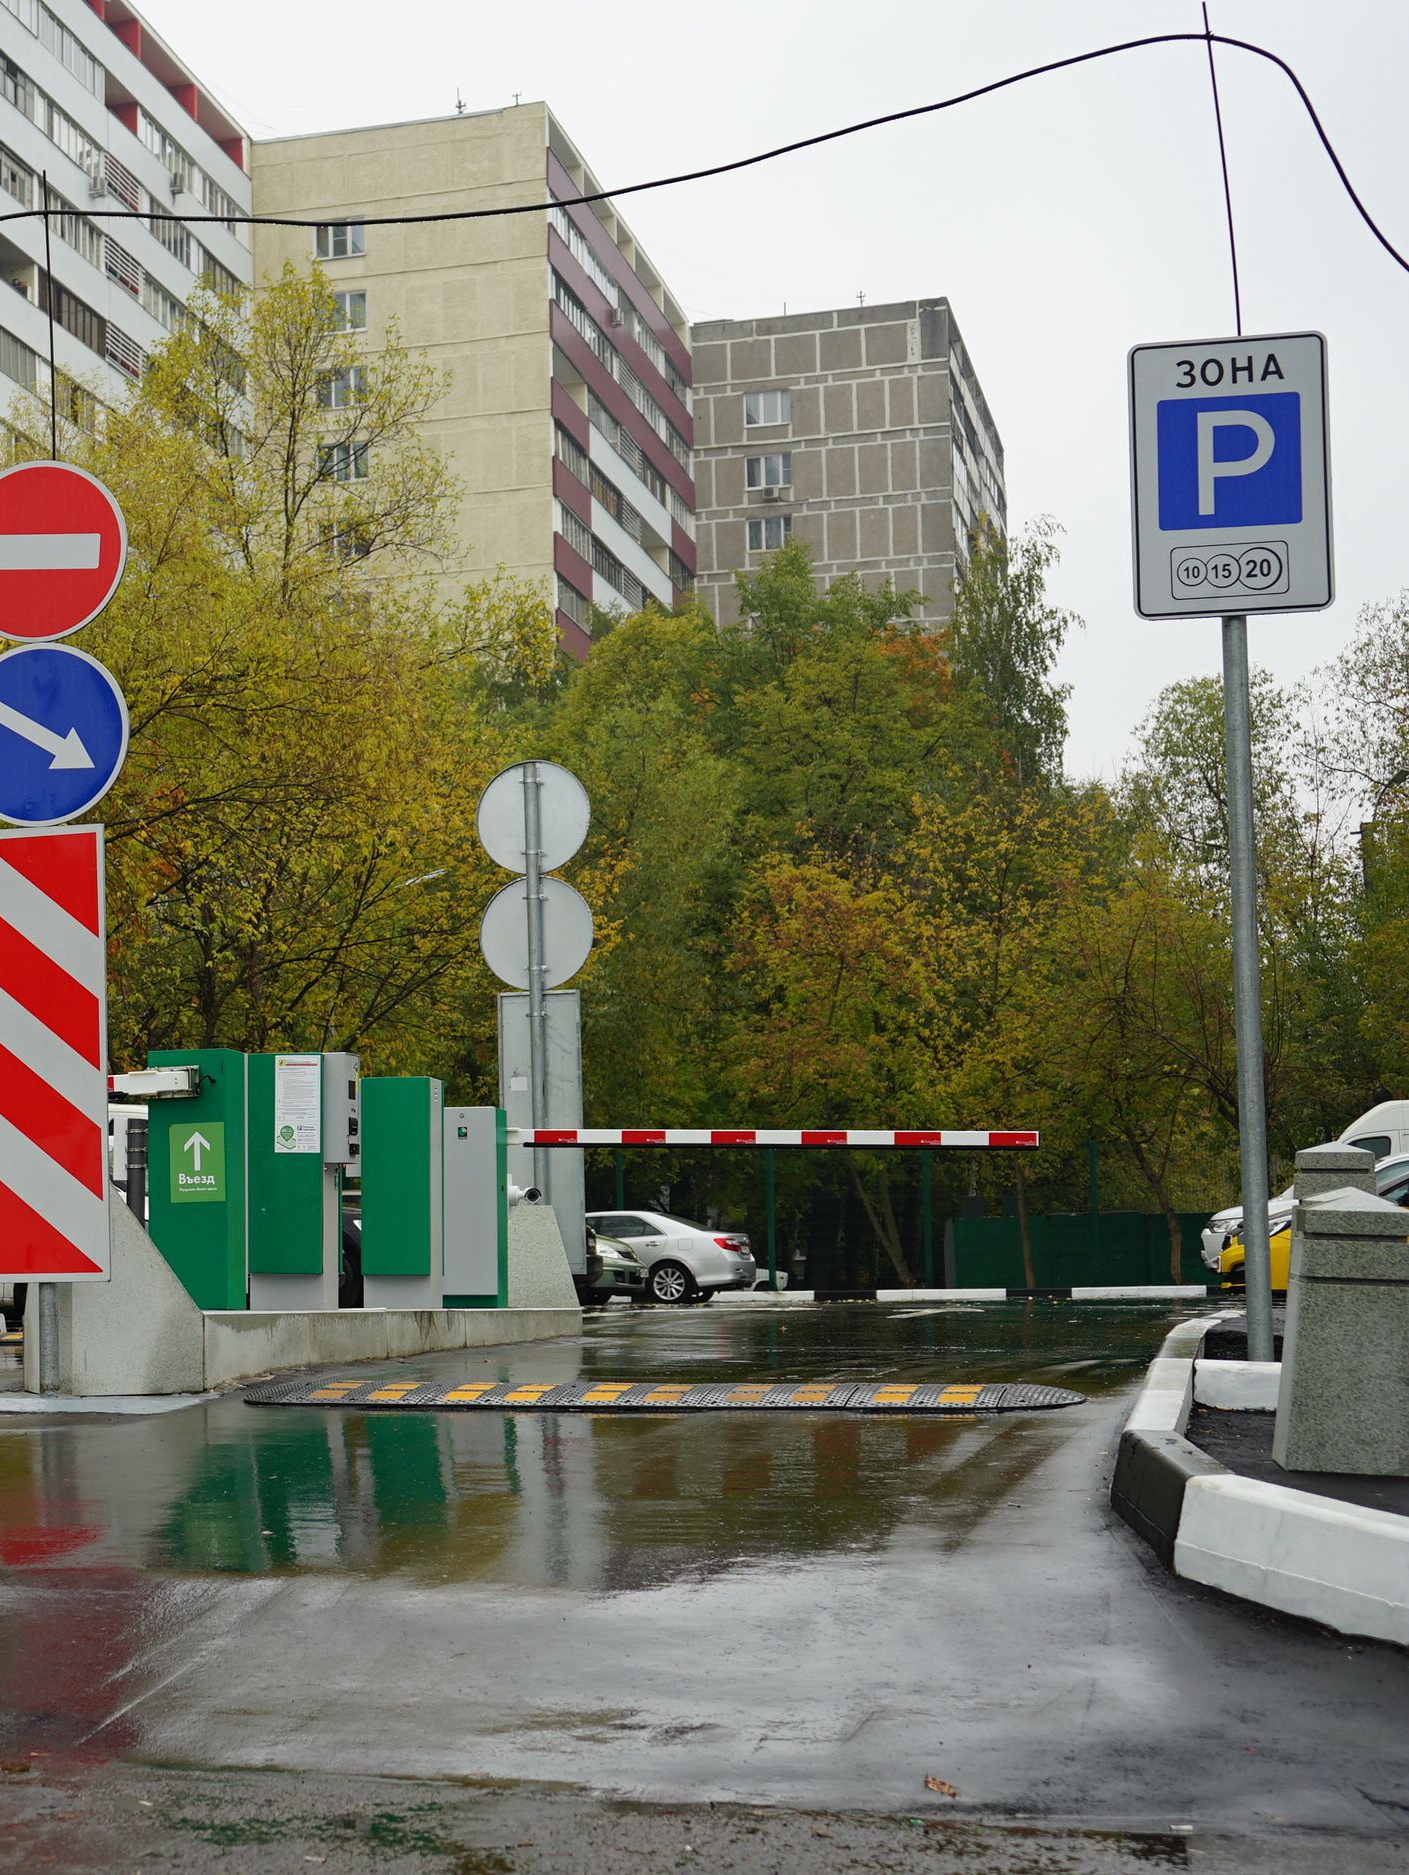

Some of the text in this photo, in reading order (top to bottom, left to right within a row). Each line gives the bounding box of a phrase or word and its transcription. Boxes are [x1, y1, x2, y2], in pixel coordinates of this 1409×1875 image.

[1176, 353, 1285, 388] ЗОНА
[1197, 410, 1276, 515] P
[1183, 558, 1271, 579] 10 15 20
[179, 1173, 215, 1185] Въезд
